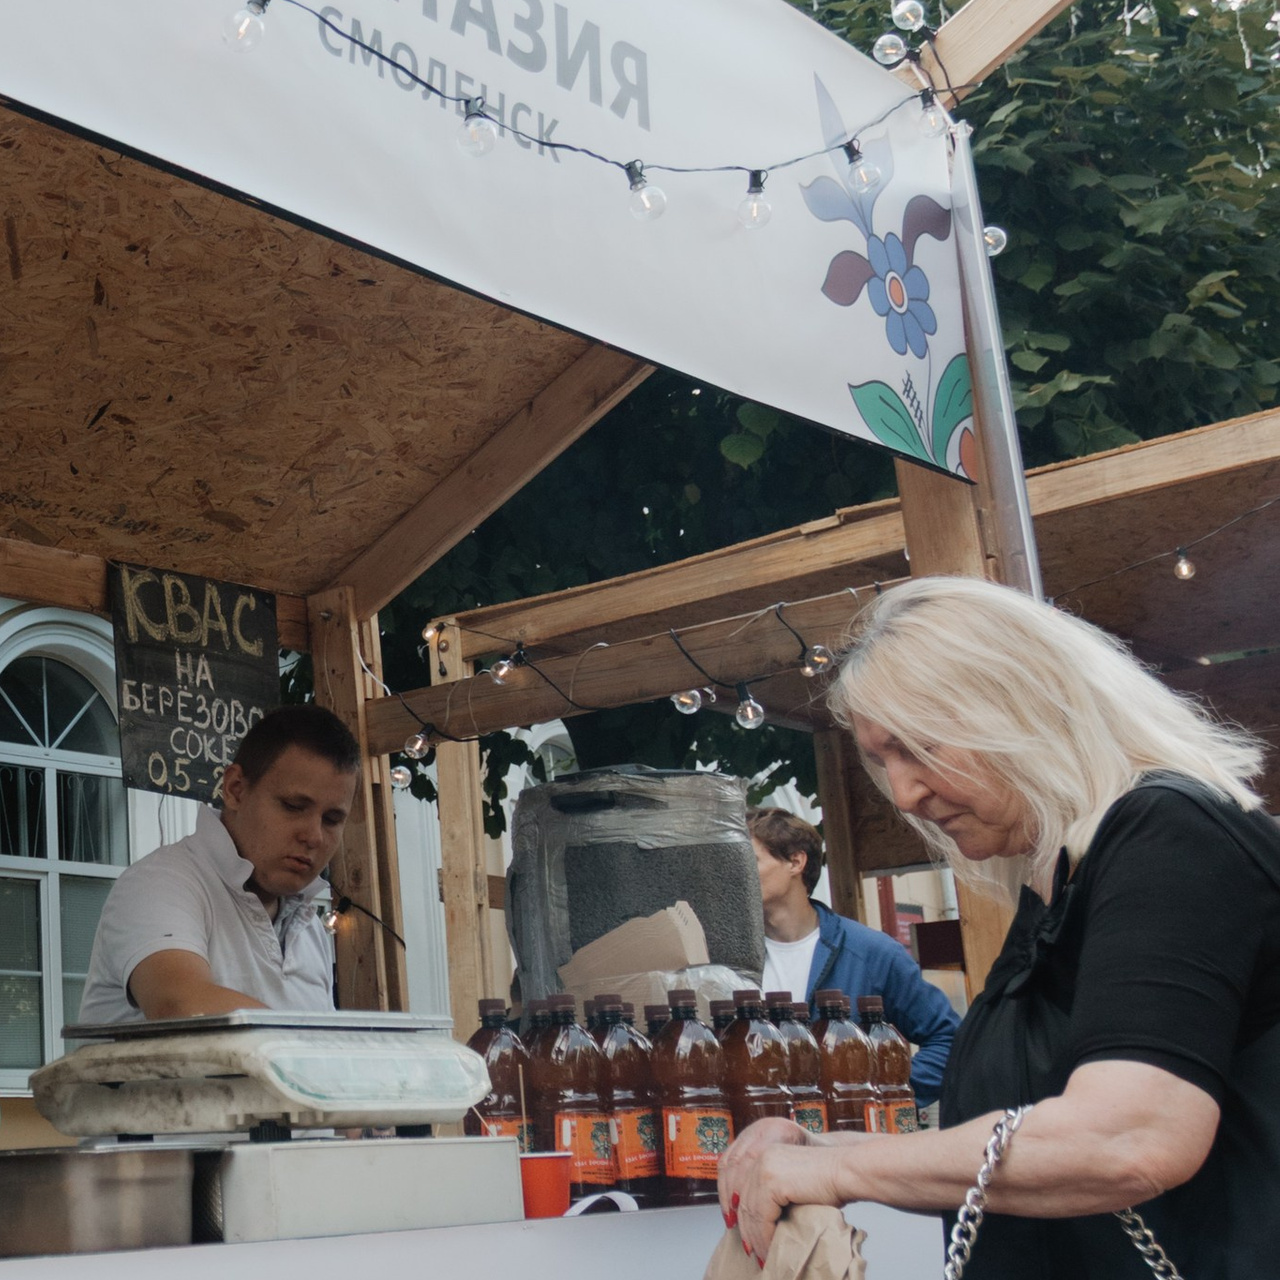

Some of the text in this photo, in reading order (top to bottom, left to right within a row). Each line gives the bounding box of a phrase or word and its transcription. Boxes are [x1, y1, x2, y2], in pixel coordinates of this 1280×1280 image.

[318, 5, 561, 163] СМОЛЕНСК
[121, 564, 264, 657] КВАС
[175, 648, 215, 692] НА
[170, 726, 237, 764] СОКЕ
